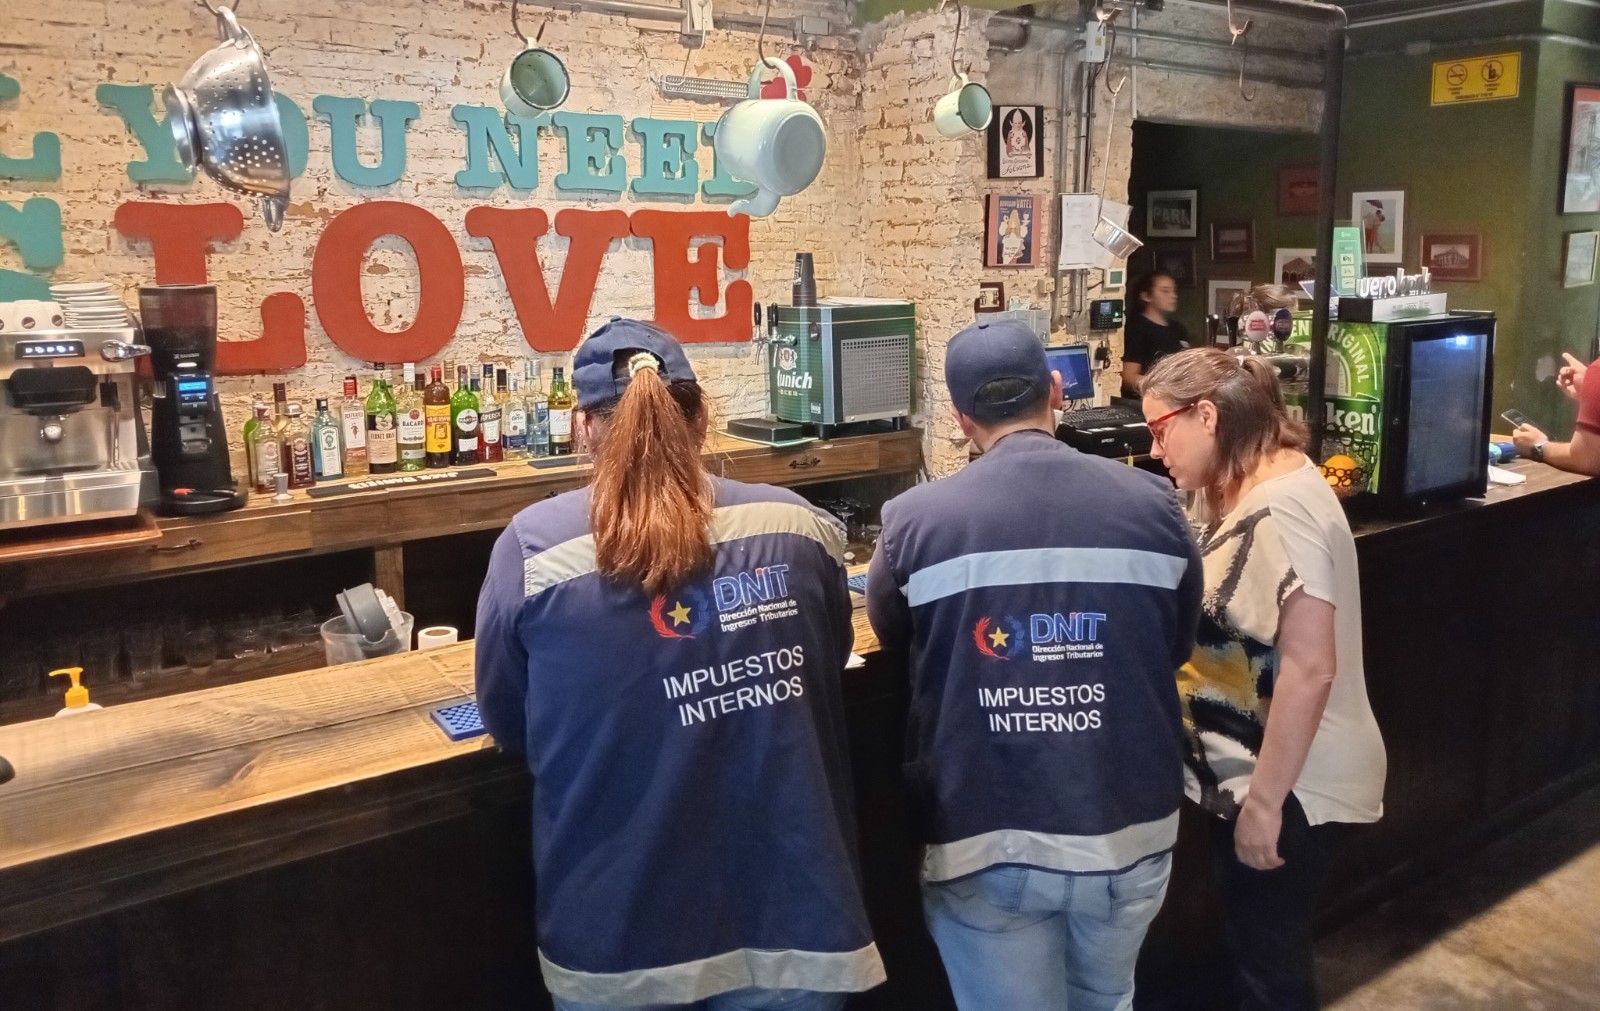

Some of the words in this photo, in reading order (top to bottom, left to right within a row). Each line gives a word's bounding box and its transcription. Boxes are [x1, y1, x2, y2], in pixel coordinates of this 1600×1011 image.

[97, 83, 419, 188] YU
[115, 200, 752, 374] LOVE
[1327, 323, 1370, 384] RIGINAL
[712, 564, 790, 612] DNIT
[719, 606, 758, 623] Dirección
[757, 600, 788, 613] Nacional
[788, 599, 797, 607] de
[720, 616, 758, 633] Ingresos
[759, 608, 799, 623] Tributarios
[1030, 612, 1107, 643] DNIT
[1032, 644, 1066, 653] Dirección
[1066, 643, 1094, 651] Nacional
[1032, 653, 1065, 663] Ingresos
[1066, 651, 1104, 660] Tributarios
[662, 645, 804, 699] IMPUESTOS
[678, 675, 804, 726] INTERNOS
[978, 683, 1106, 708] IMPUESTOS
[989, 709, 1102, 733] INTERNOS
